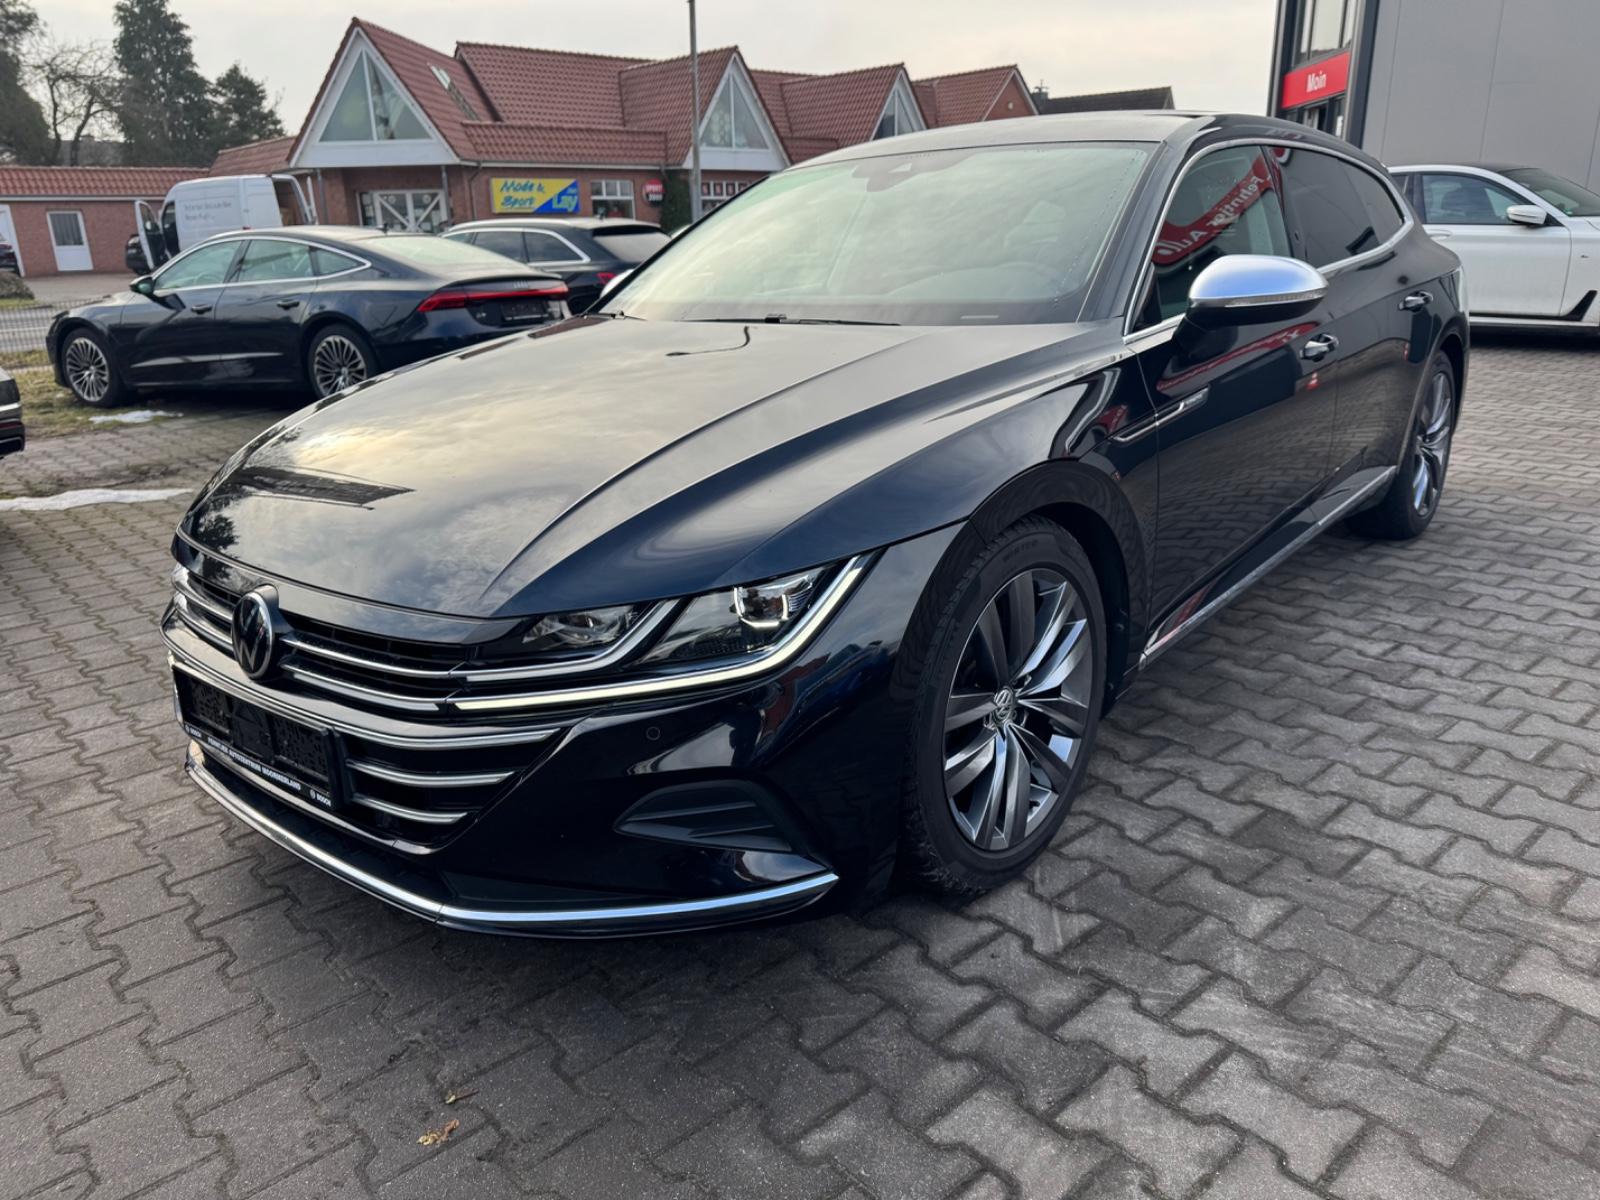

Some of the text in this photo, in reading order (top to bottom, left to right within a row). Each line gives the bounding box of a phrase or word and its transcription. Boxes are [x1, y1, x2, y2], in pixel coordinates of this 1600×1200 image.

[1306, 70, 1327, 93] Moin
[500, 180, 535, 193] Mode
[501, 195, 534, 209] Sport
